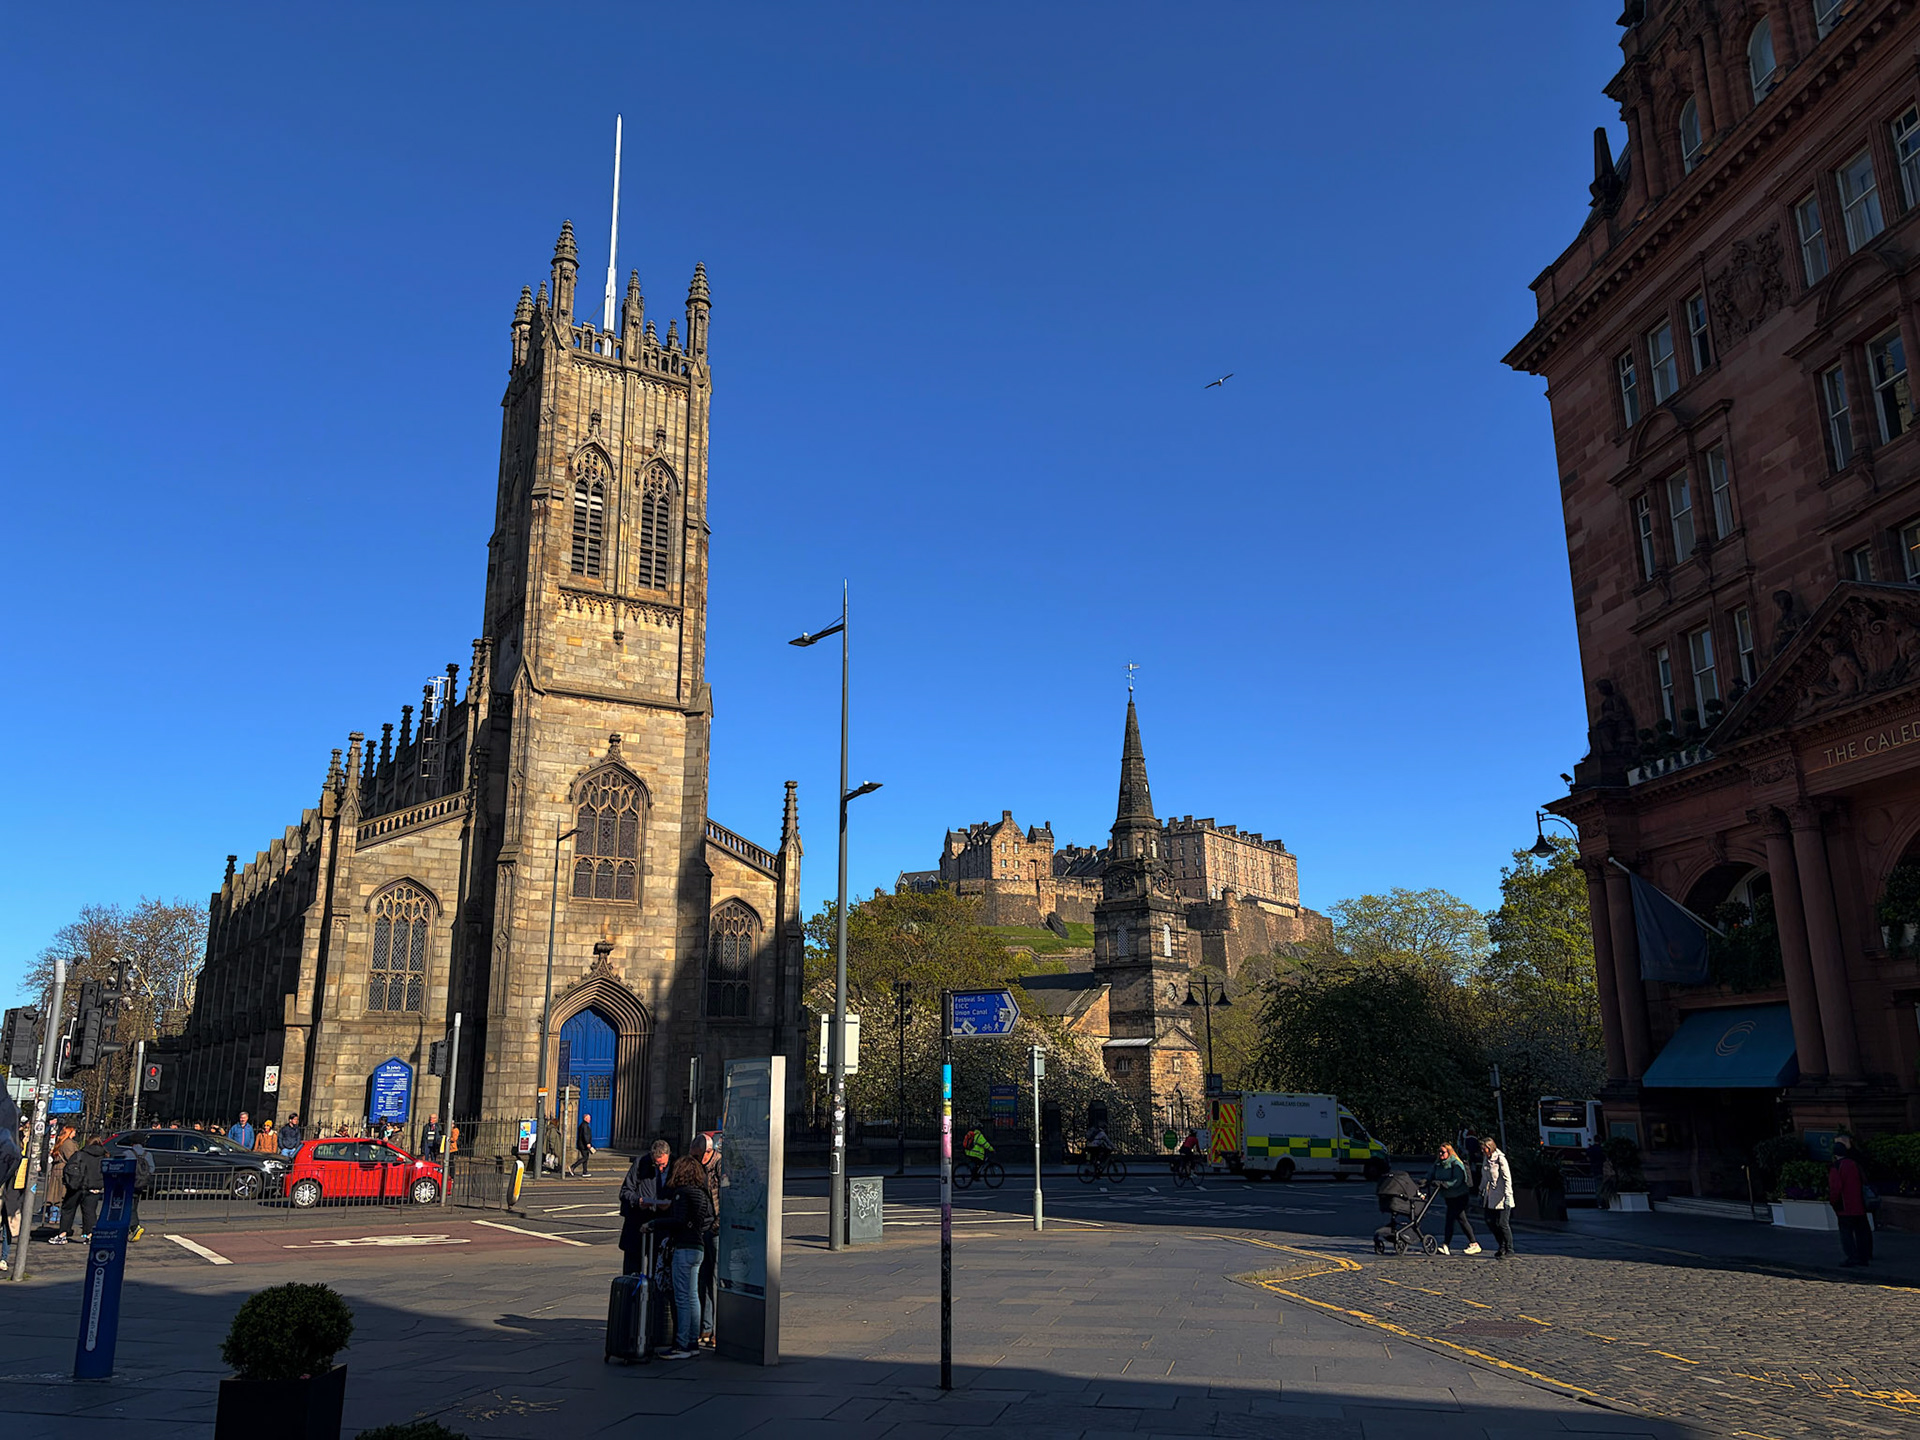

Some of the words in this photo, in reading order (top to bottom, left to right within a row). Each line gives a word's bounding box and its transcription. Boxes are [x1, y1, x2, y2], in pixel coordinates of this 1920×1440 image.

[1823, 742, 1858, 765] THE
[1864, 721, 1920, 753] CALED
[972, 1008, 987, 1016] Canal
